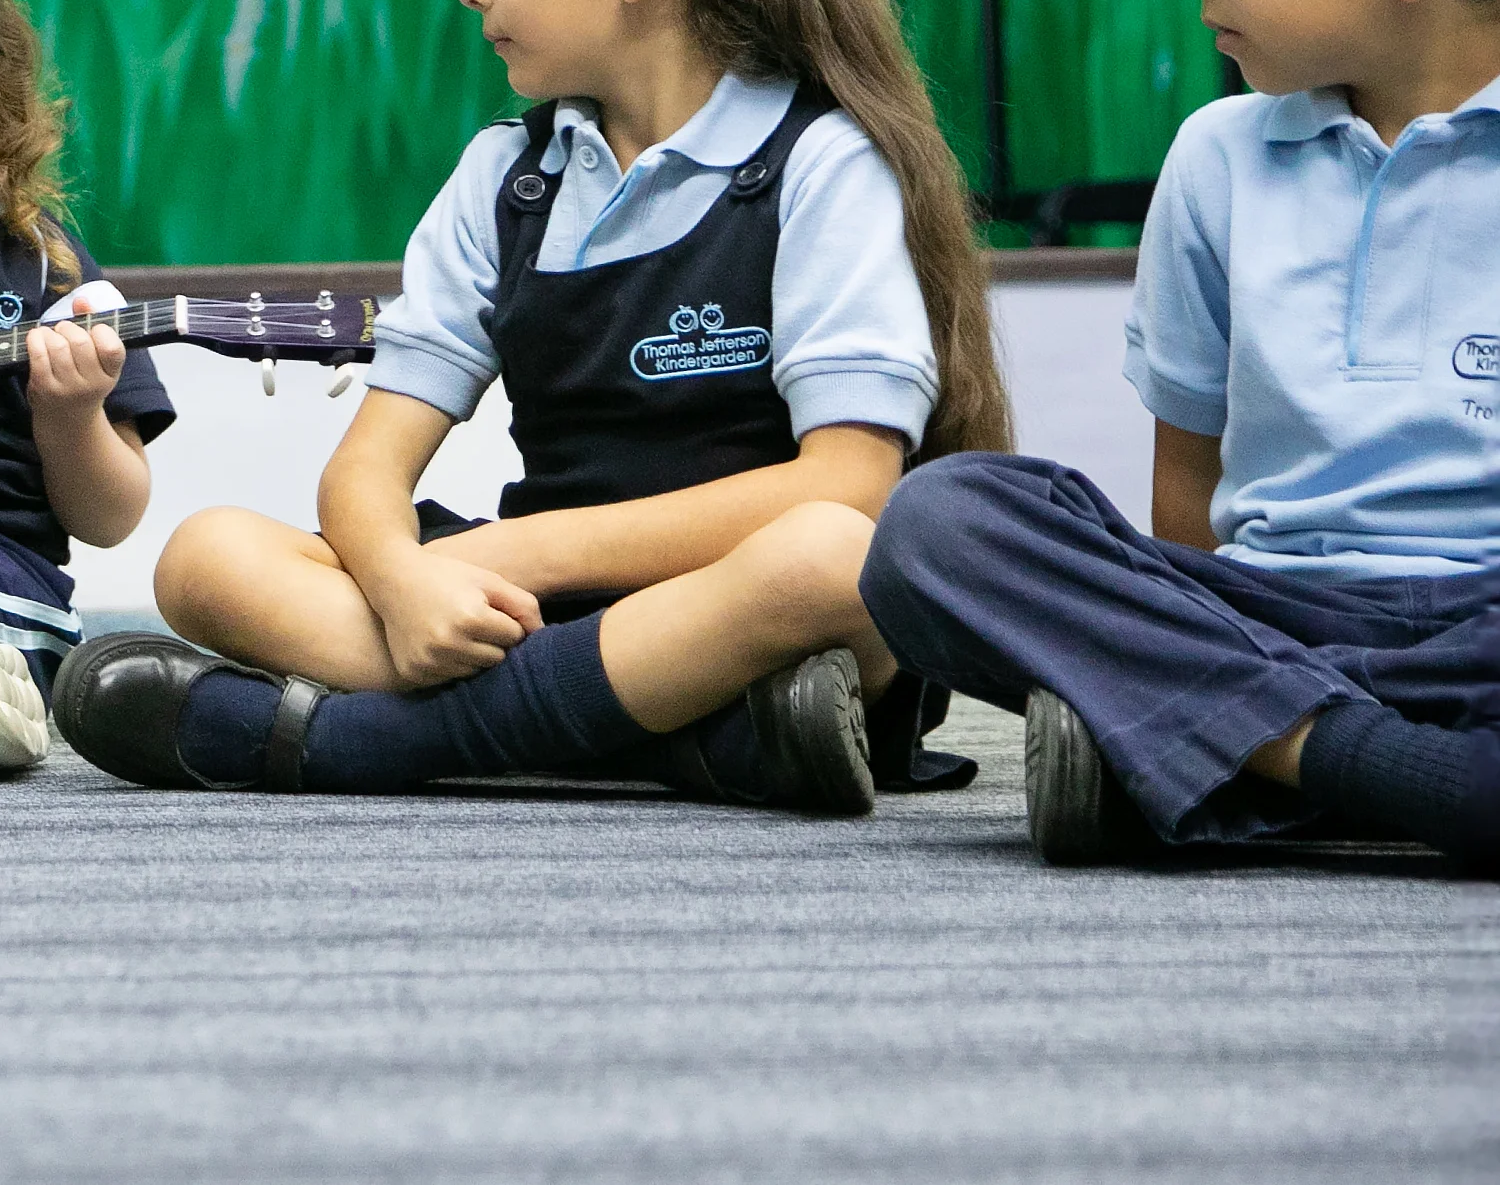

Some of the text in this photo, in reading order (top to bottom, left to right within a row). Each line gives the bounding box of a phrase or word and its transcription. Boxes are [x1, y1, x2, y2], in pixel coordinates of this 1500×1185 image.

[641, 334, 765, 360] Thomas Jefferson
[655, 350, 756, 372] Kindergarden
